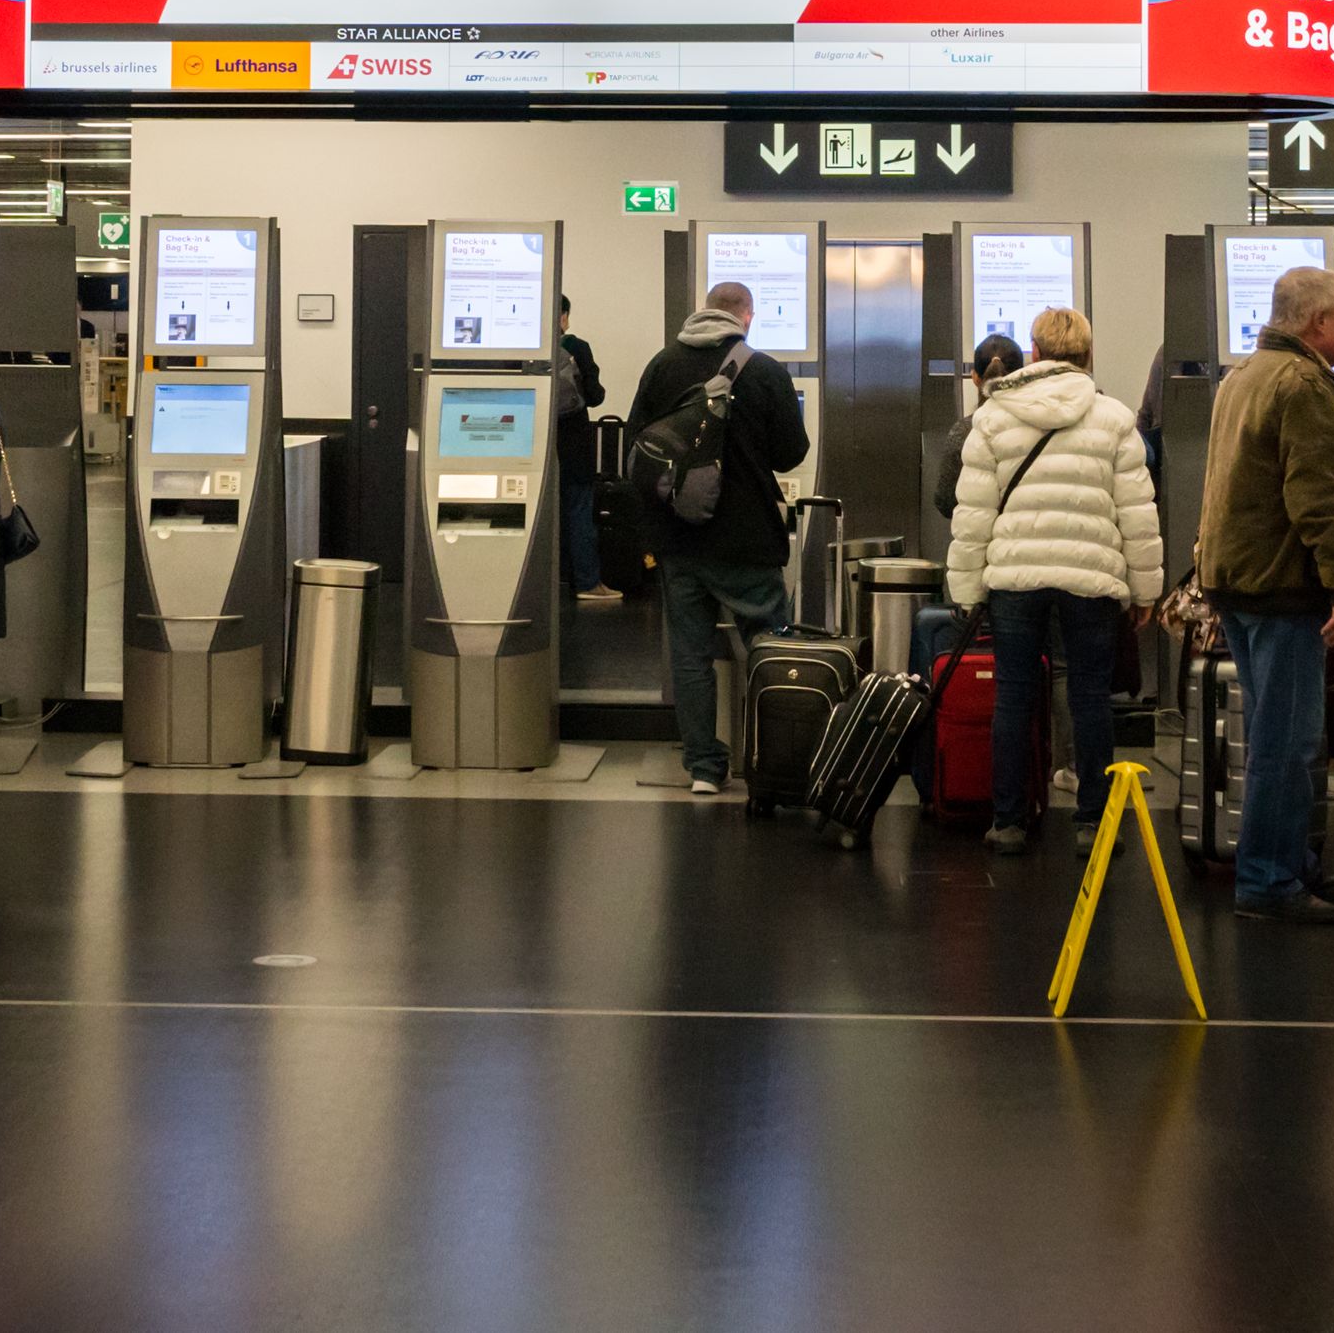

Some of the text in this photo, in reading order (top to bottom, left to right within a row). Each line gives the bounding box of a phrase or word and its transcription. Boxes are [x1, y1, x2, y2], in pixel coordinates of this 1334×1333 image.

[930, 27, 1005, 38] other Airlines
[1244, 8, 1274, 48] &
[337, 28, 462, 41] STAR ALLIANCE
[474, 50, 540, 59] ADRIA
[814, 50, 855, 60] Bulgaria
[951, 53, 994, 63] Luxair
[61, 61, 157, 73] brussels airlines
[215, 59, 298, 73] Lufthansa
[361, 58, 432, 76] SWISS
[466, 74, 485, 82] LOT
[715, 239, 752, 247] Check-in
[980, 241, 1017, 249] Check-in
[1233, 243, 1269, 251] Check-in
[165, 244, 199, 252] Bag Tag
[452, 247, 485, 255] Bag Tag
[715, 248, 748, 257] Bag Tag
[980, 250, 1013, 258] Bag Tag
[1251, 253, 1266, 261] Tag
